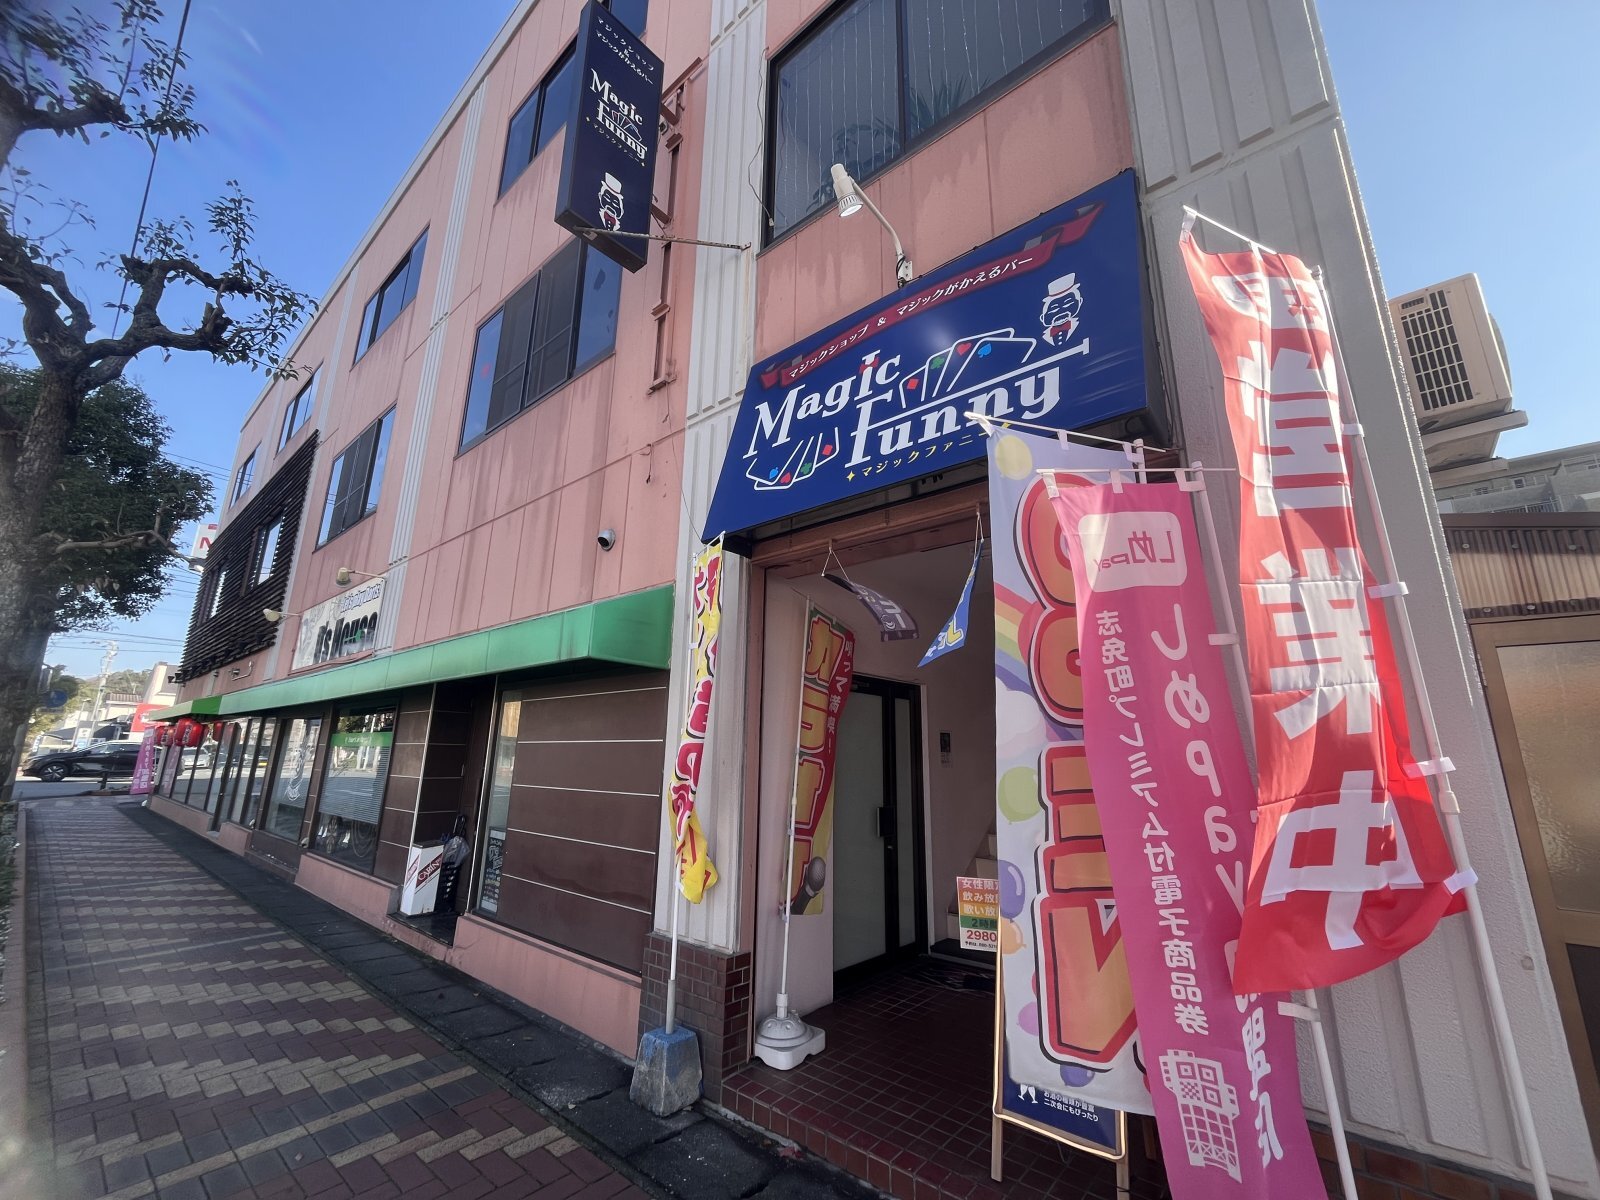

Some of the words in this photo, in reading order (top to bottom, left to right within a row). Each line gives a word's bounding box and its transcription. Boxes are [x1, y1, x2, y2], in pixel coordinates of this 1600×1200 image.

[597, 16, 654, 71] マジックショップ
[590, 68, 643, 125] Magic
[596, 99, 647, 159] Funny
[789, 324, 869, 379] マジックショップ
[877, 316, 887, 327] &
[896, 255, 1034, 316] マジックがかえるバー
[742, 349, 901, 460] Magic
[845, 345, 1085, 469] Funny
[418, 861, 440, 881] CABIN
[962, 878, 999, 891] 女性限
[963, 891, 999, 904] 飲み放
[963, 905, 999, 917] 歌い放
[967, 930, 997, 942] 2980
[1043, 1098, 1099, 1122] 二次会にもぴったり
